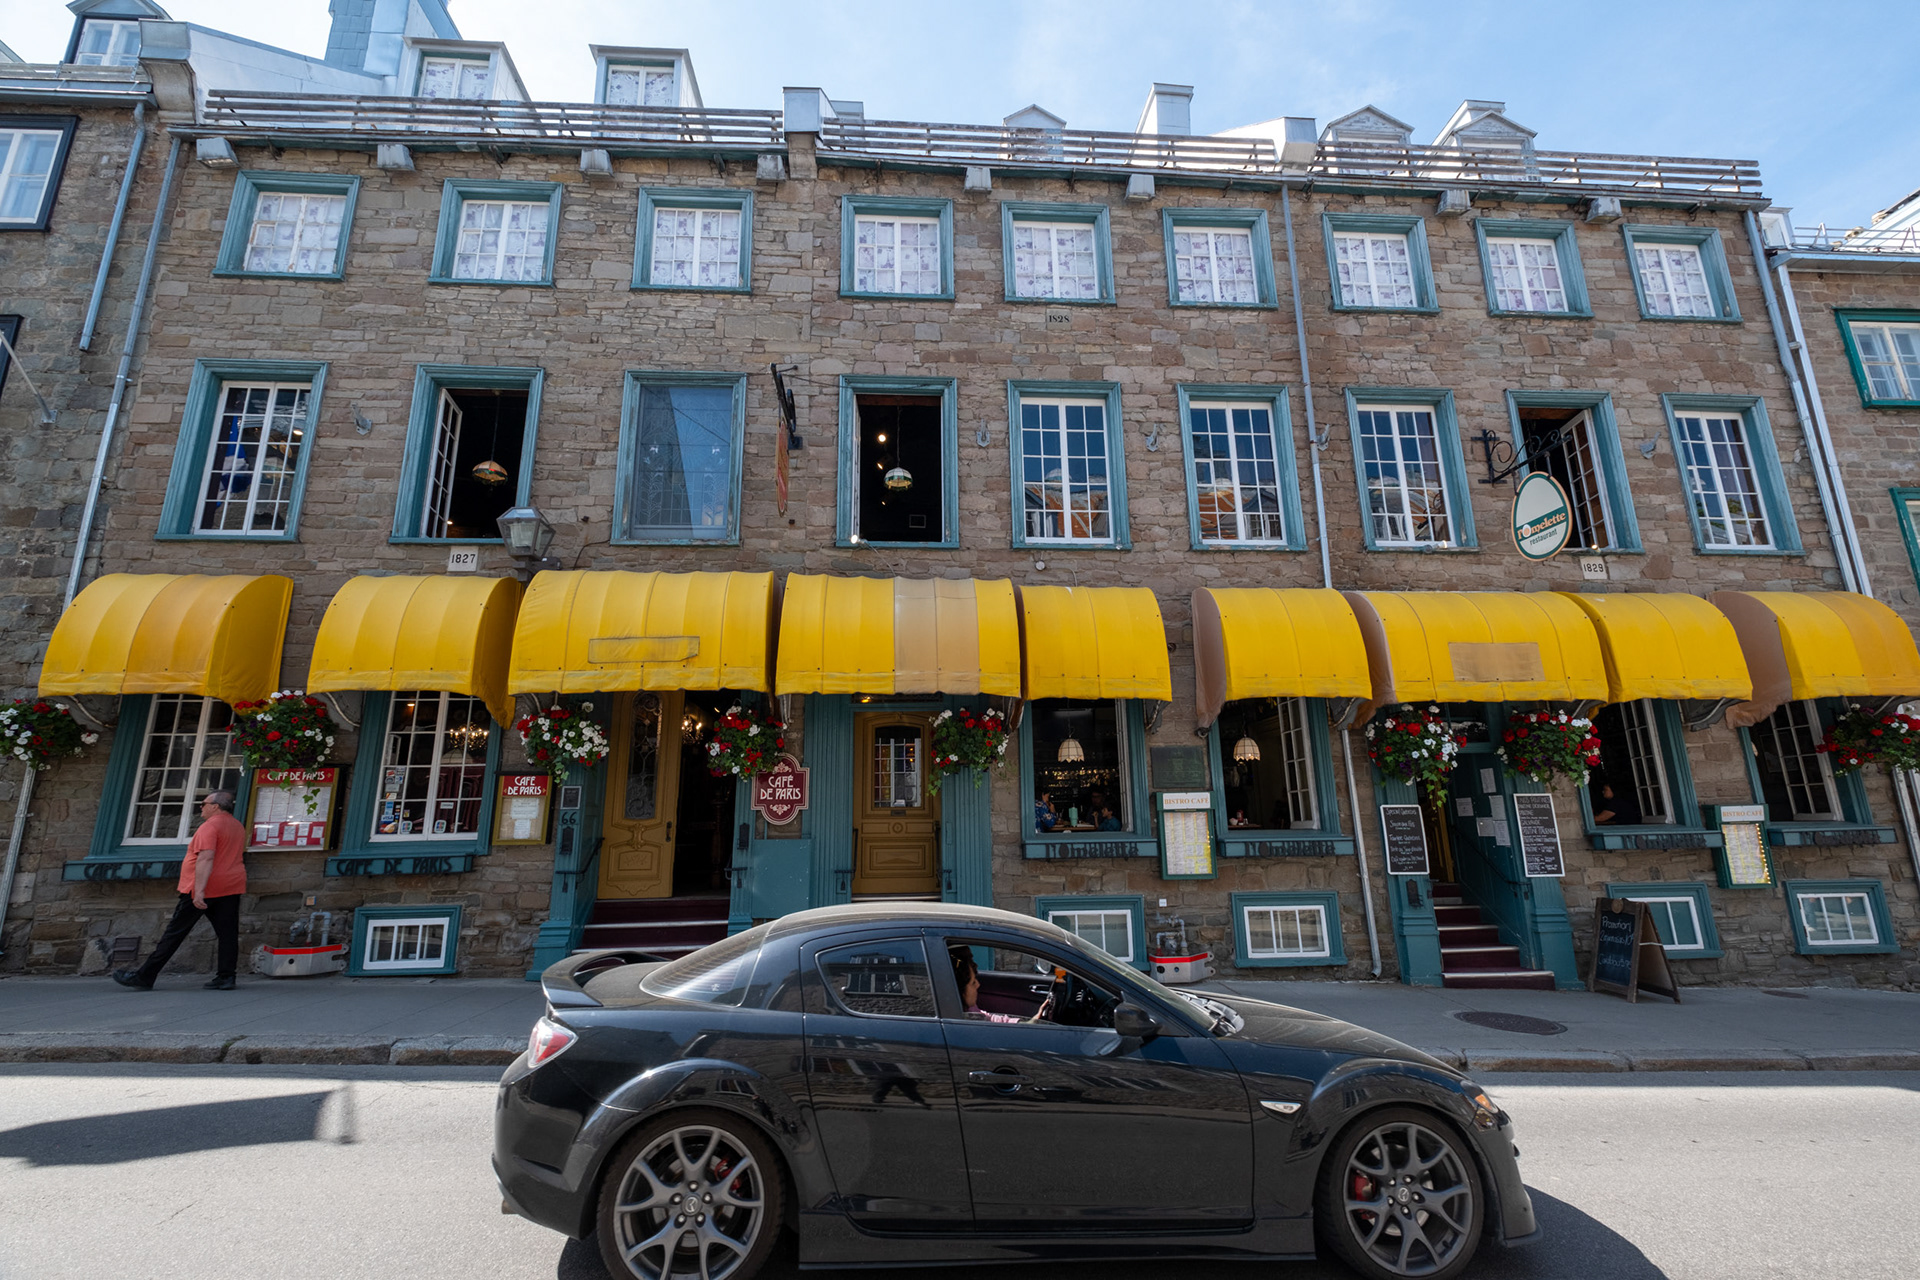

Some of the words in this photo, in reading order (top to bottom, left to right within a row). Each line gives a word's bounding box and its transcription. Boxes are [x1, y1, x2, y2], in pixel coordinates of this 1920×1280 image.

[1049, 315, 1070, 323] 1828
[1529, 528, 1558, 546] restaurant
[451, 553, 476, 563] 1827
[1583, 563, 1604, 573] 1829
[289, 771, 301, 781] DE
[768, 775, 794, 788] CAFÉ
[507, 786, 519, 795] DE
[520, 786, 542, 795] PARIS
[760, 788, 773, 800] DE
[775, 788, 801, 800] PARIS
[1191, 796, 1209, 804] CAFÉ
[561, 812, 577, 825] 66
[130, 863, 153, 879] DE
[384, 859, 402, 875] DE
[413, 857, 453, 874] PARIS
